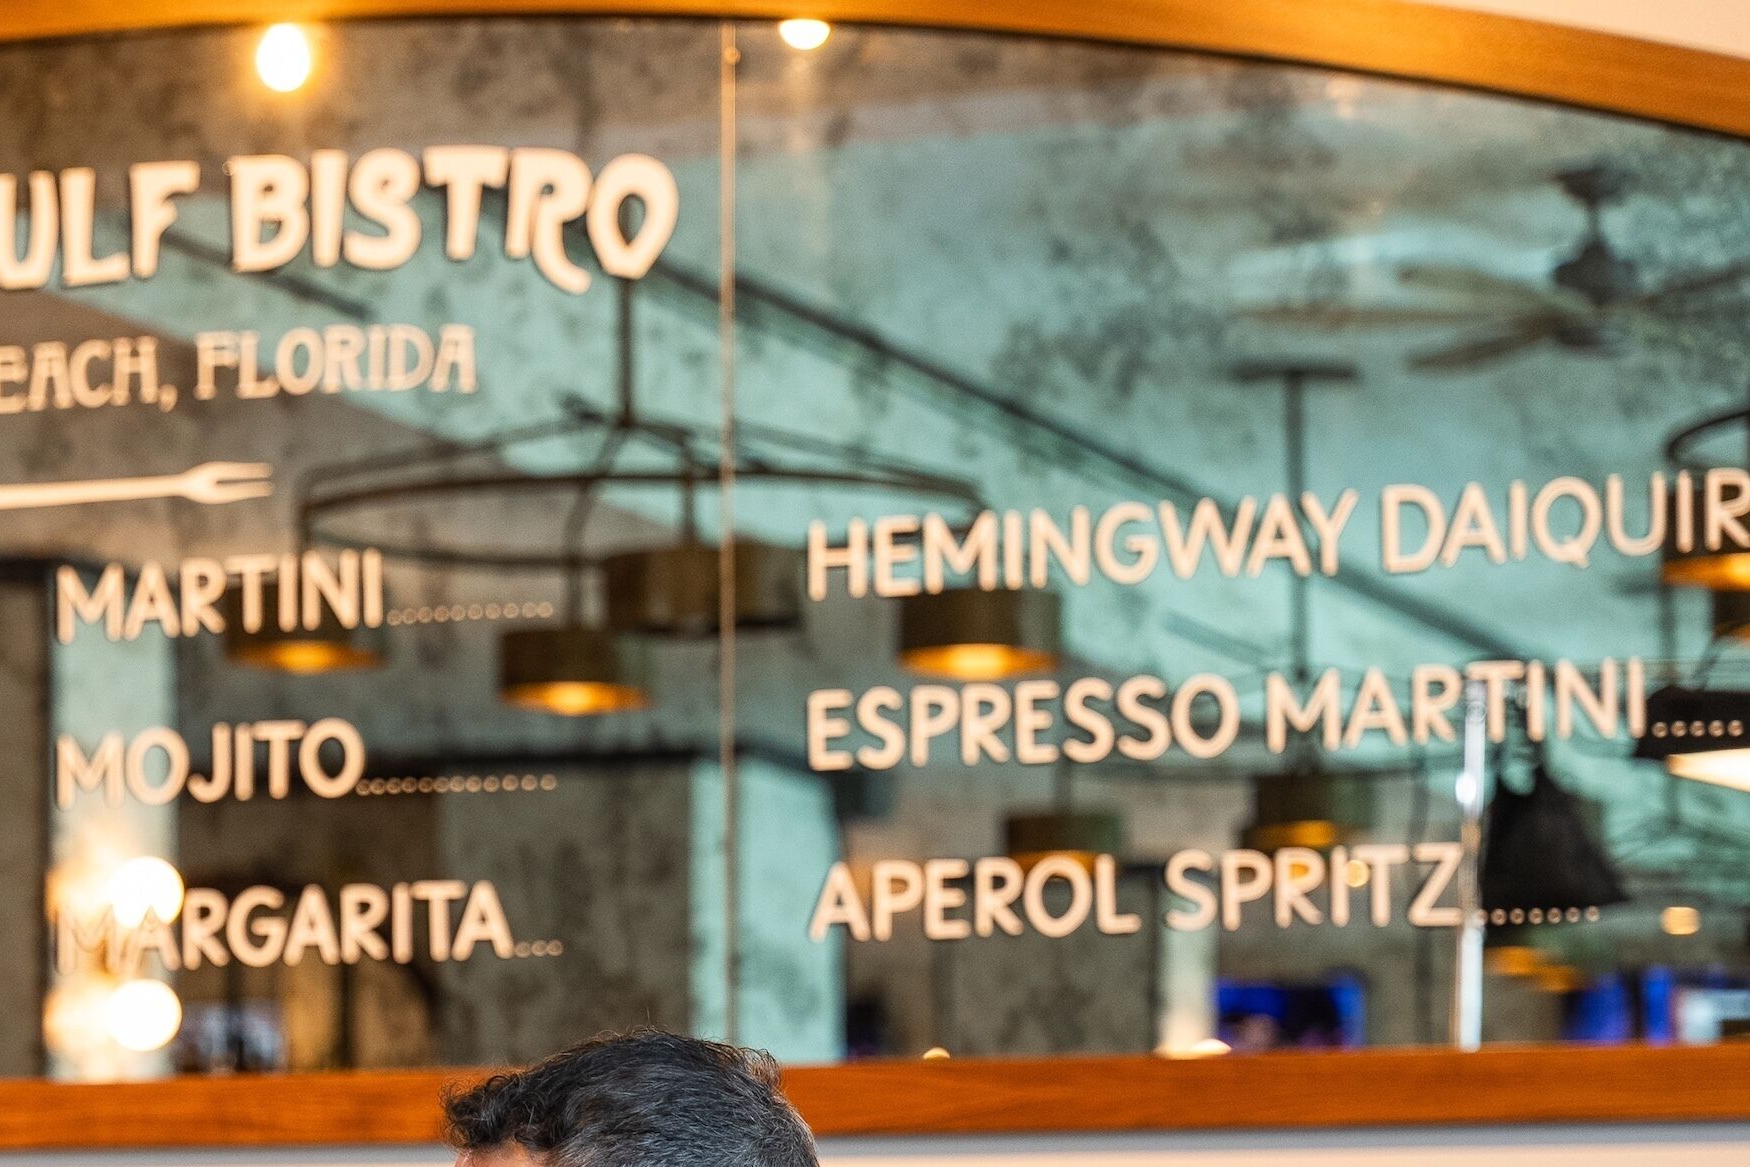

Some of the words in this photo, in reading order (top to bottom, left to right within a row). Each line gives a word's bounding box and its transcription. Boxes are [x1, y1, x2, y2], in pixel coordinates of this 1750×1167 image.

[229, 144, 680, 294] BISTRO
[193, 323, 478, 400] FLORIDA
[56, 547, 384, 645] MARTINI
[807, 489, 1358, 602] HEMINGWAY
[56, 717, 366, 811] MOJITO
[807, 673, 1241, 771] ESPRESSO
[1265, 656, 1647, 754] MARTINI
[809, 853, 1142, 942] APEROL
[1165, 841, 1464, 933] SPRITZ
